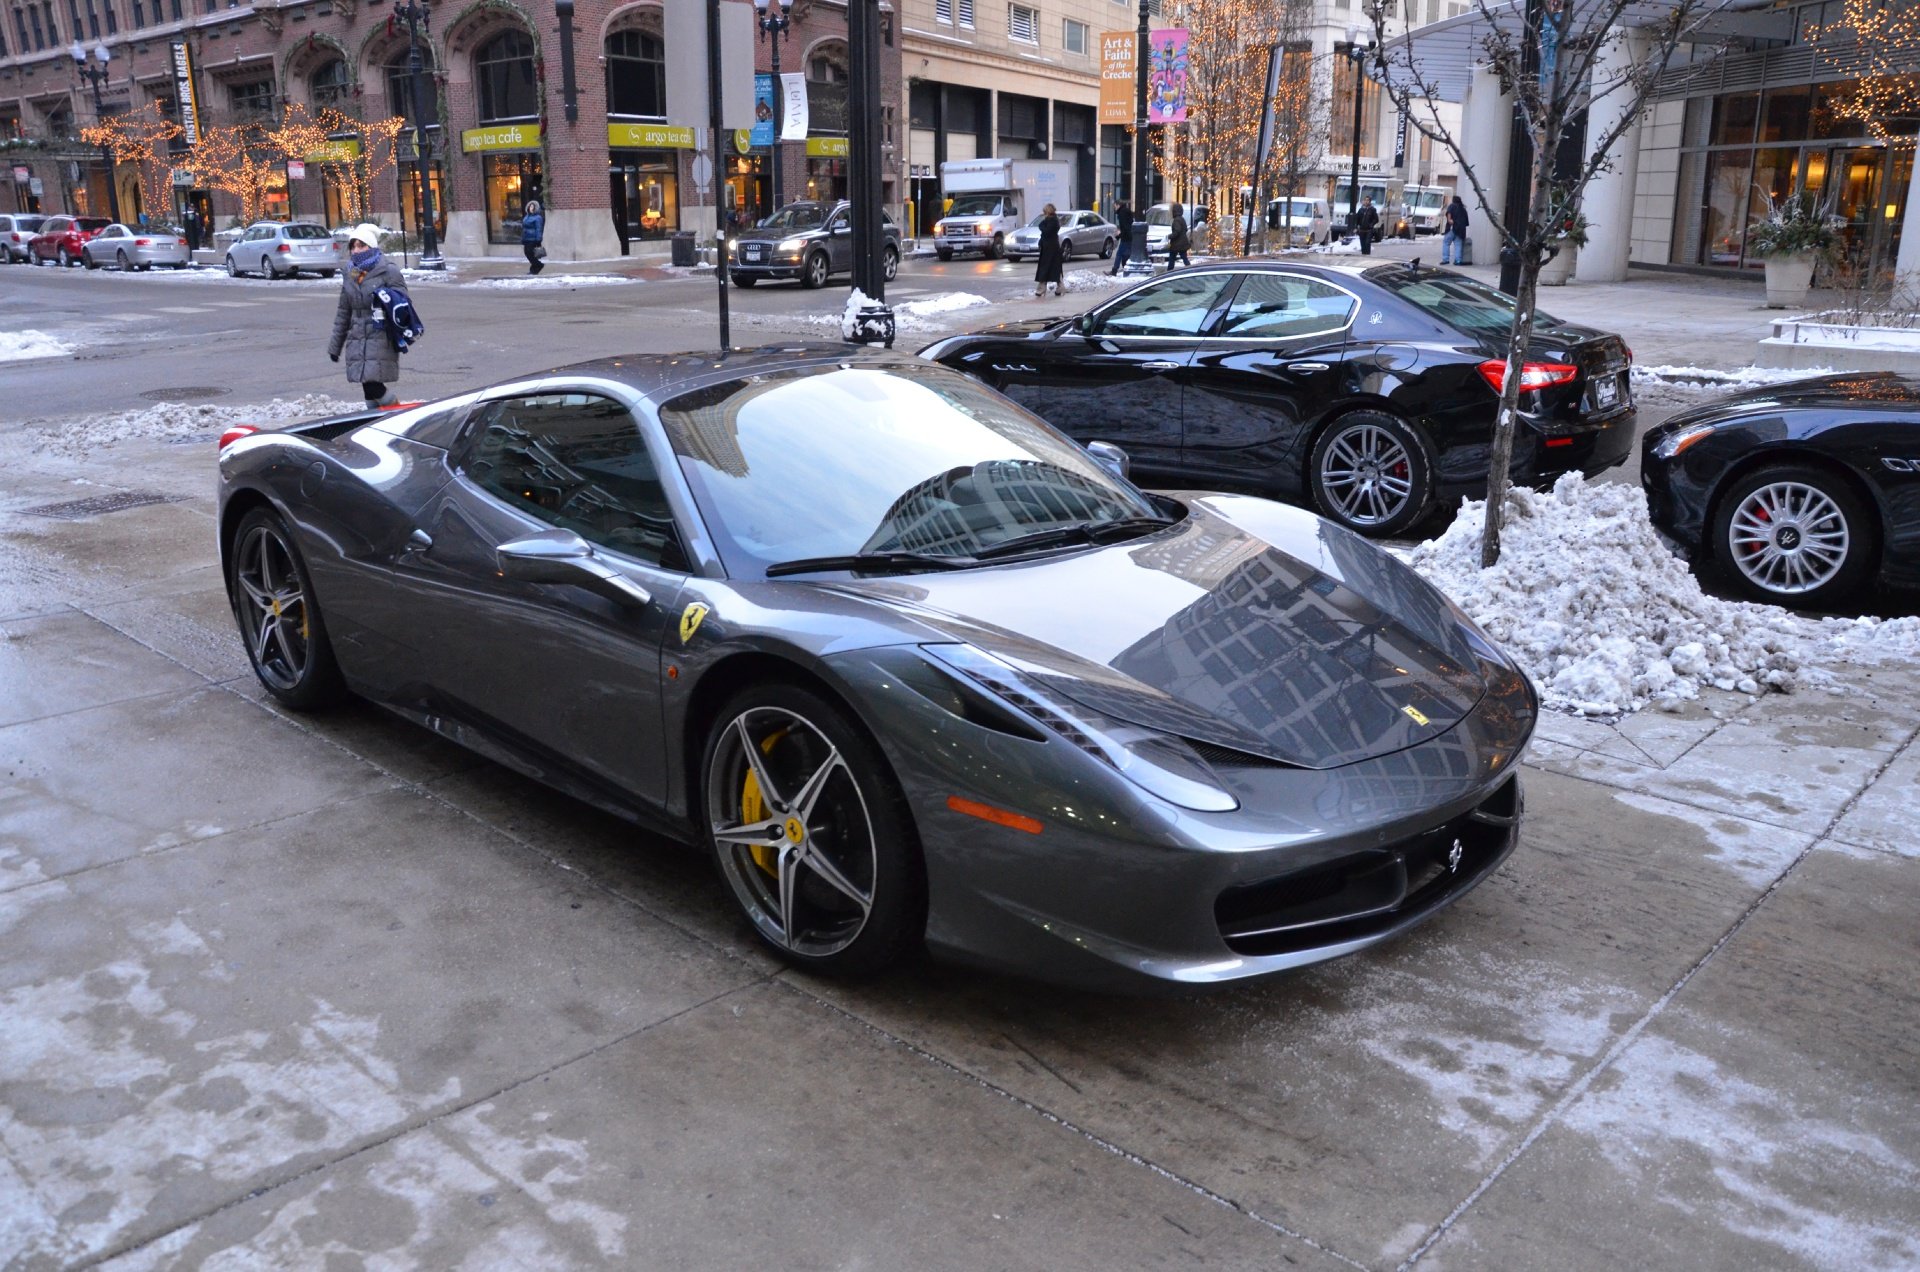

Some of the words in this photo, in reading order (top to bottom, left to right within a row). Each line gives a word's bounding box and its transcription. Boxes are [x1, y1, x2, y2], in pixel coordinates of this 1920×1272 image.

[1104, 37, 1122, 49] Art
[1124, 38, 1132, 48] &
[173, 44, 189, 78] BAGELS
[1104, 49, 1131, 61] Faith
[1109, 61, 1116, 71] of
[1116, 61, 1126, 69] the
[1102, 70, 1133, 79] Creche
[1105, 109, 1127, 117] LUMA
[182, 105, 197, 144] EINSTEIN
[484, 133, 496, 145] tea
[498, 127, 522, 144] café
[645, 131, 667, 146] argo
[668, 131, 679, 142] tea
[1396, 133, 1405, 155] rack
